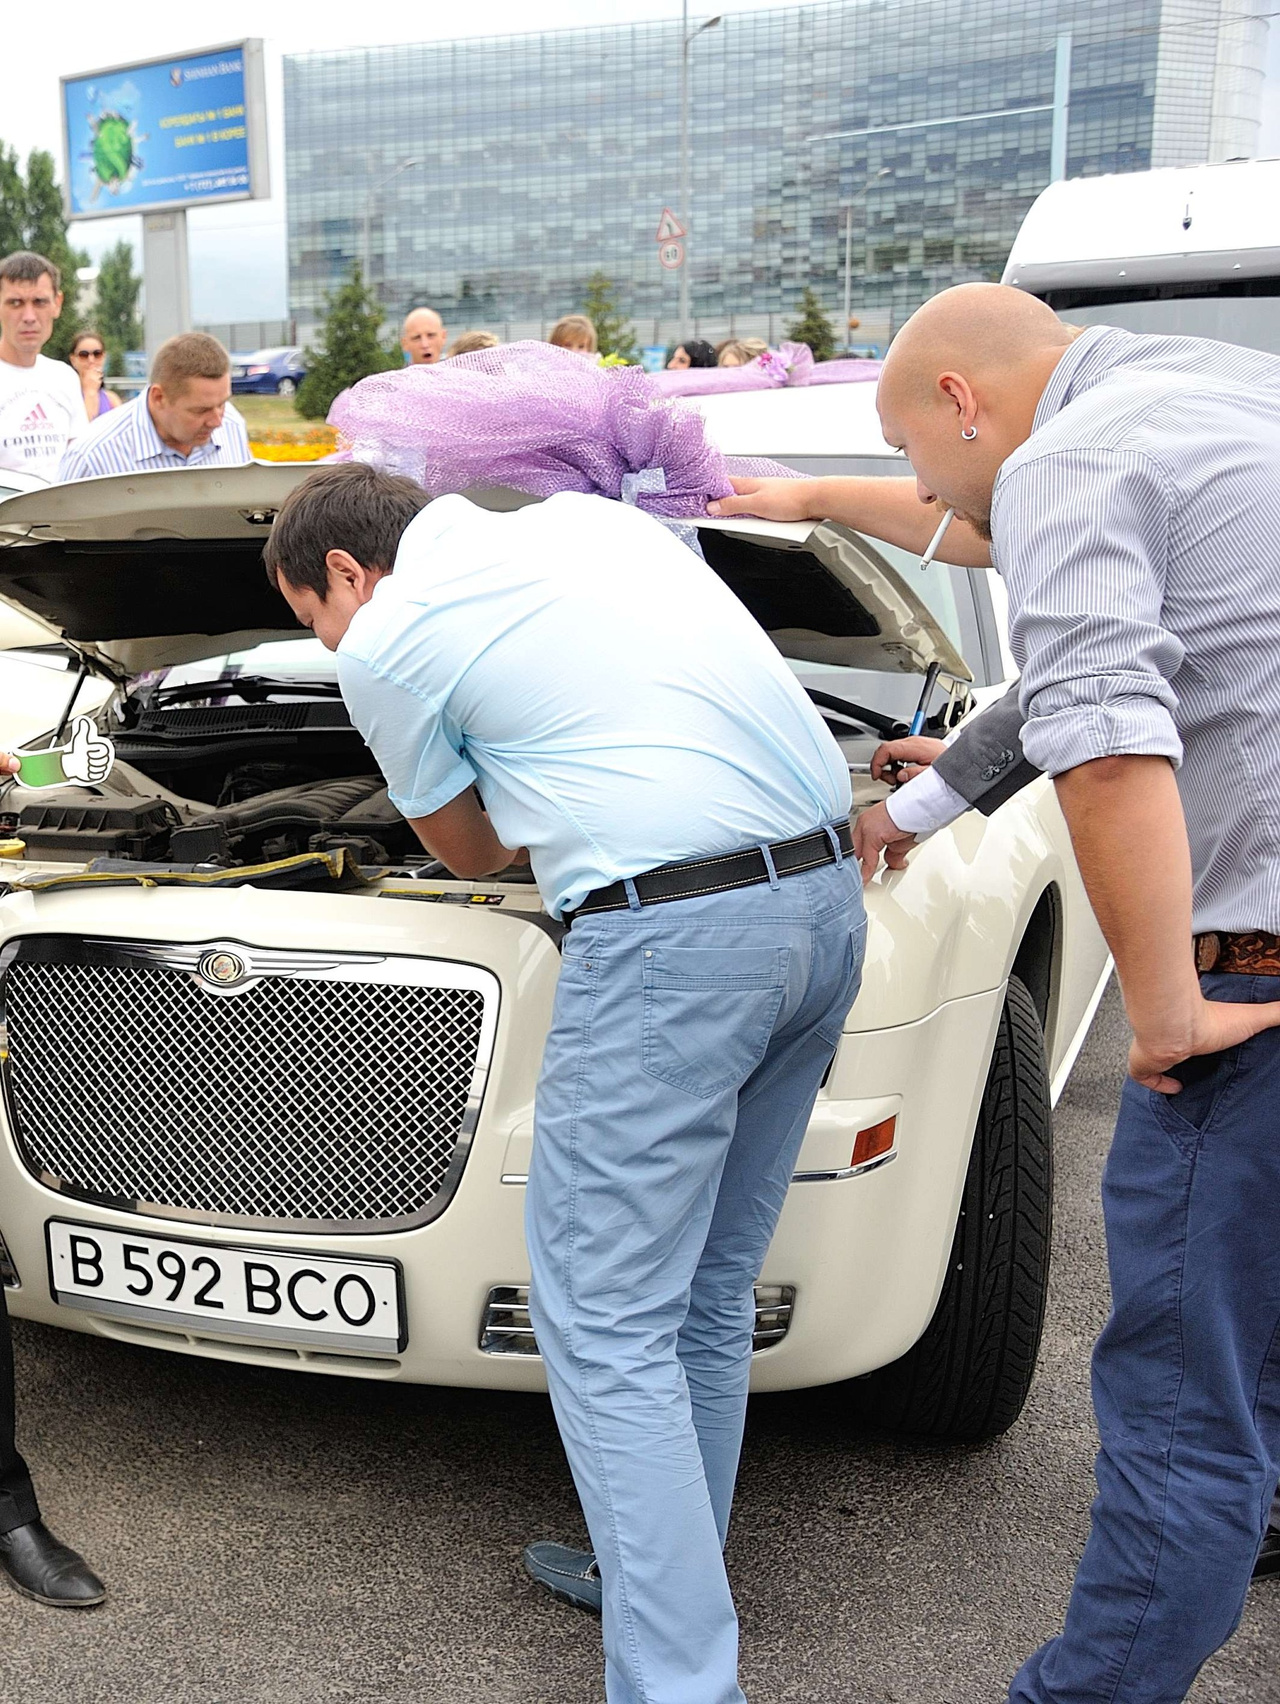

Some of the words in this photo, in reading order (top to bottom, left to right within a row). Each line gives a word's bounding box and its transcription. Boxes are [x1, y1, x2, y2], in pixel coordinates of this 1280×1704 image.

[3, 434, 66, 448] COMFORT
[70, 1234, 104, 1287] B
[122, 1243, 224, 1310] 592
[243, 1260, 376, 1327] BCO
